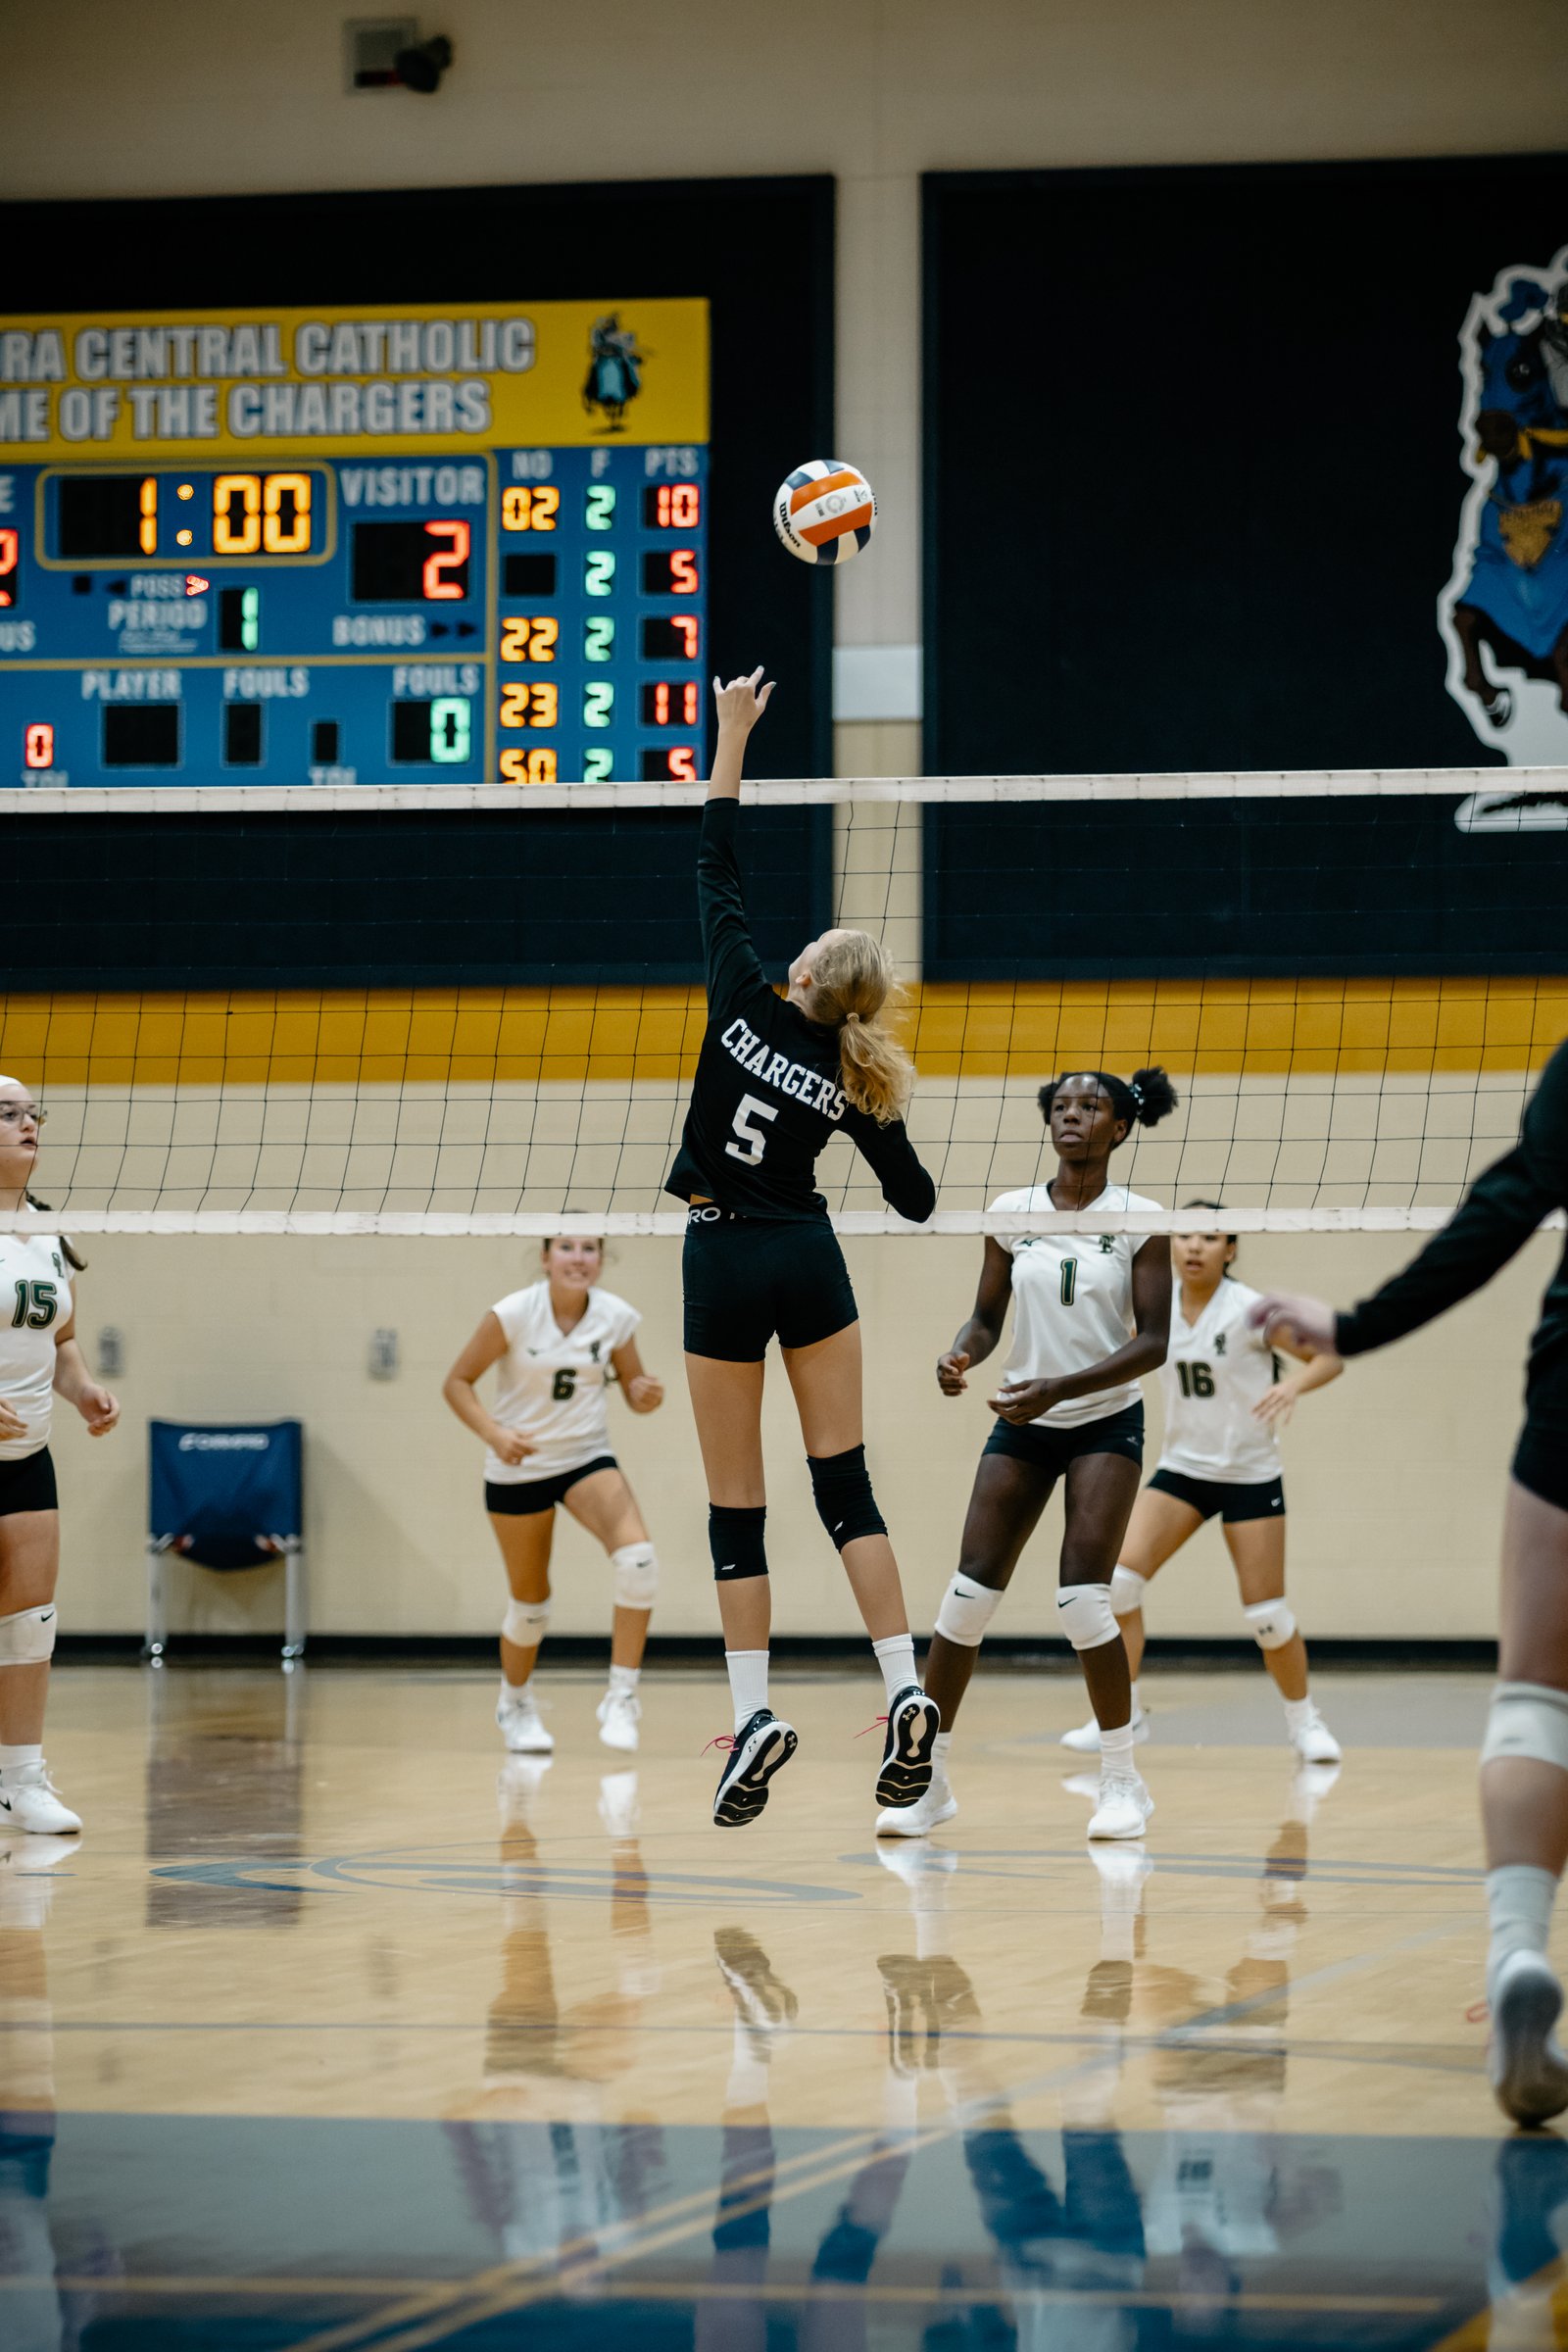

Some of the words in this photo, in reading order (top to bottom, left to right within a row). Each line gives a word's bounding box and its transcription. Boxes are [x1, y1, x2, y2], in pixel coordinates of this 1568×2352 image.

[74, 323, 288, 381] CENTRAL
[295, 318, 535, 376] CATHOLIC
[59, 385, 120, 441] OF
[127, 383, 220, 441] THE
[228, 378, 492, 438] CHARGERS
[645, 447, 699, 478] PTS
[339, 466, 485, 507] VISITOR
[502, 486, 560, 531] 02
[585, 484, 616, 530] 2
[657, 483, 699, 528] 10
[139, 472, 312, 556] 1:00
[422, 519, 470, 600] 2
[585, 551, 615, 596] 2
[669, 549, 698, 594] 5
[108, 599, 208, 630] PERIOD
[241, 587, 259, 651] 1
[332, 614, 426, 647] BONUS
[500, 616, 559, 662] 22
[584, 616, 614, 662] 2
[670, 614, 698, 660] 7
[81, 669, 182, 700] PLAYER
[222, 667, 310, 698] FOULS
[393, 663, 479, 696] FOULS
[499, 682, 558, 727] 23
[583, 682, 613, 727] 2
[655, 681, 697, 725] 11
[25, 723, 54, 768] 0
[430, 698, 470, 763] 0
[499, 748, 557, 784] 50
[583, 748, 613, 783] 2
[668, 747, 696, 781] 5
[720, 1018, 850, 1121] CHARGERS
[724, 1093, 779, 1166] 5
[11, 1279, 58, 1330] 15
[1060, 1257, 1077, 1306] 1
[552, 1367, 577, 1401] 6
[1176, 1361, 1215, 1397] 16
